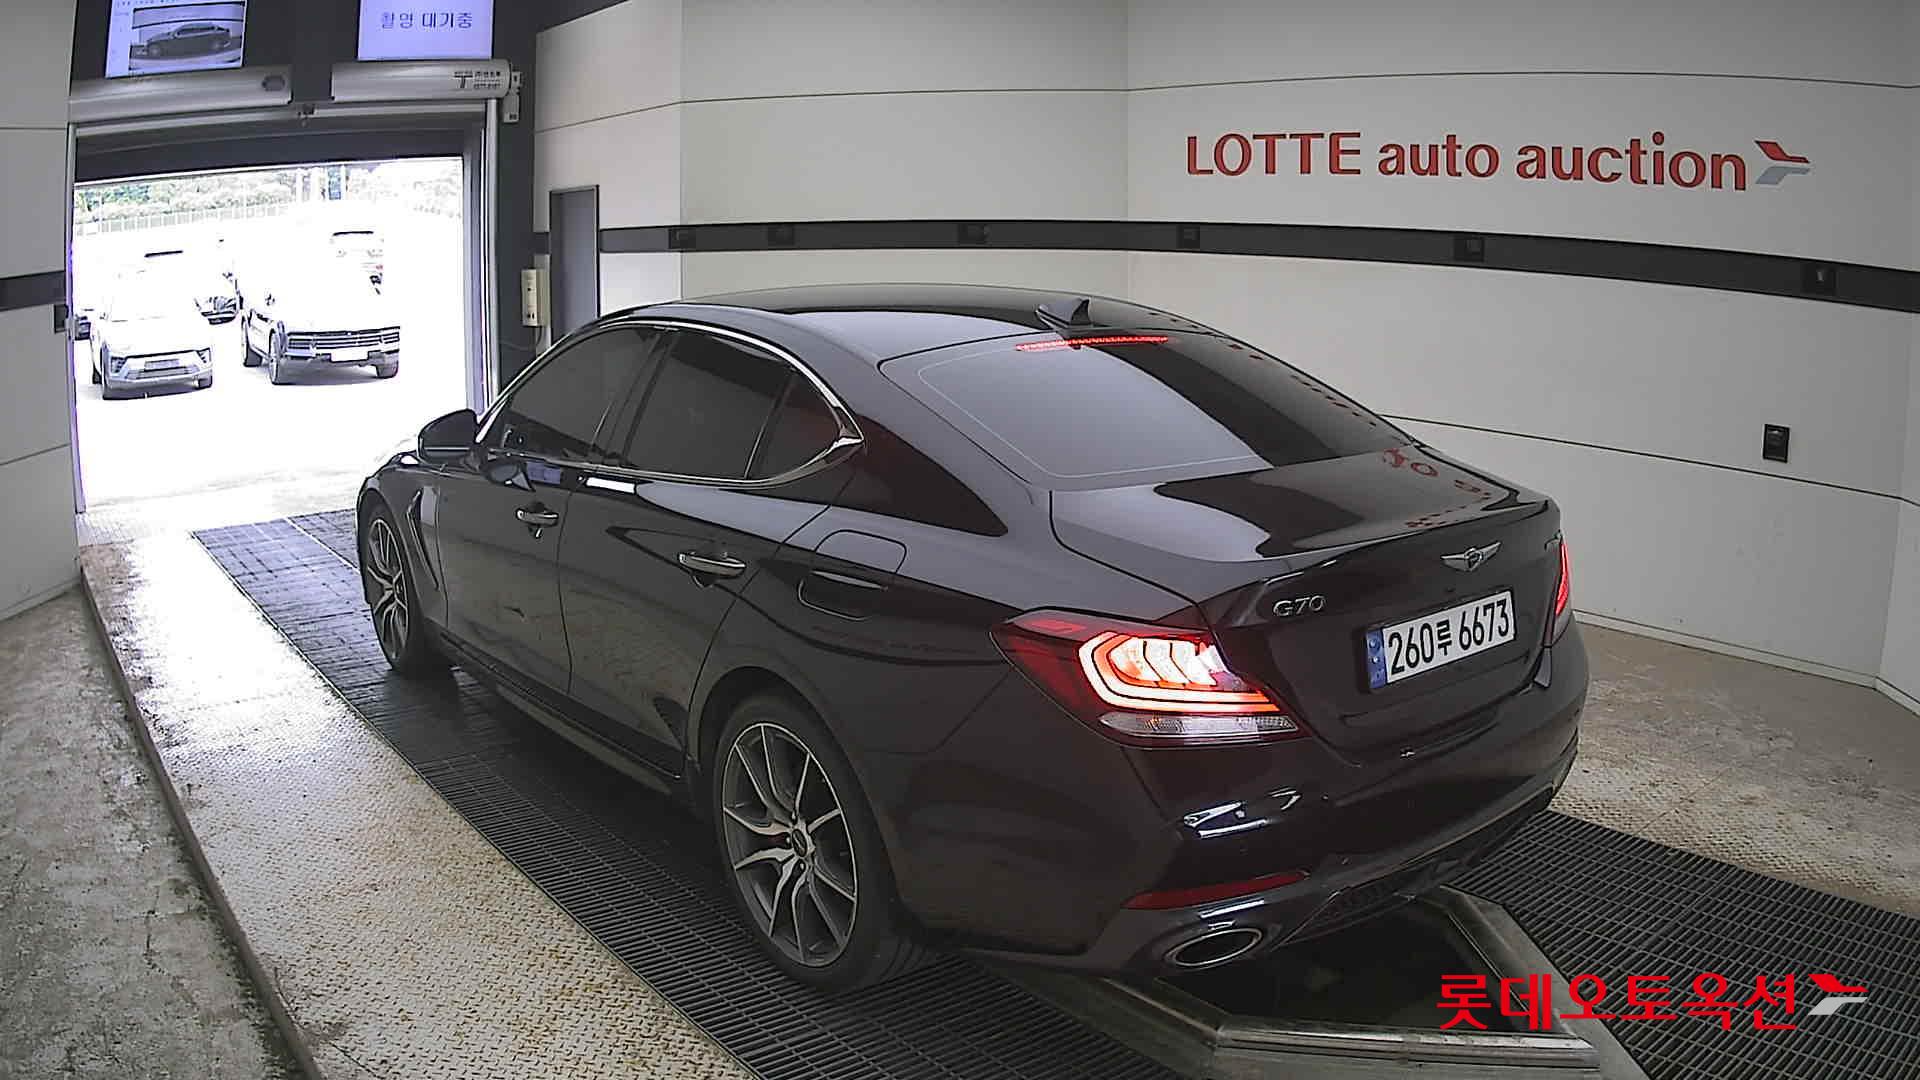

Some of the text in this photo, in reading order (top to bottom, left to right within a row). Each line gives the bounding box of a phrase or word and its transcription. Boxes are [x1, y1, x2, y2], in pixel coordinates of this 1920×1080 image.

[421, 12, 473, 29] 대기중
[1187, 131, 1747, 191] LOTTE auto auction
[1272, 595, 1325, 616] G70
